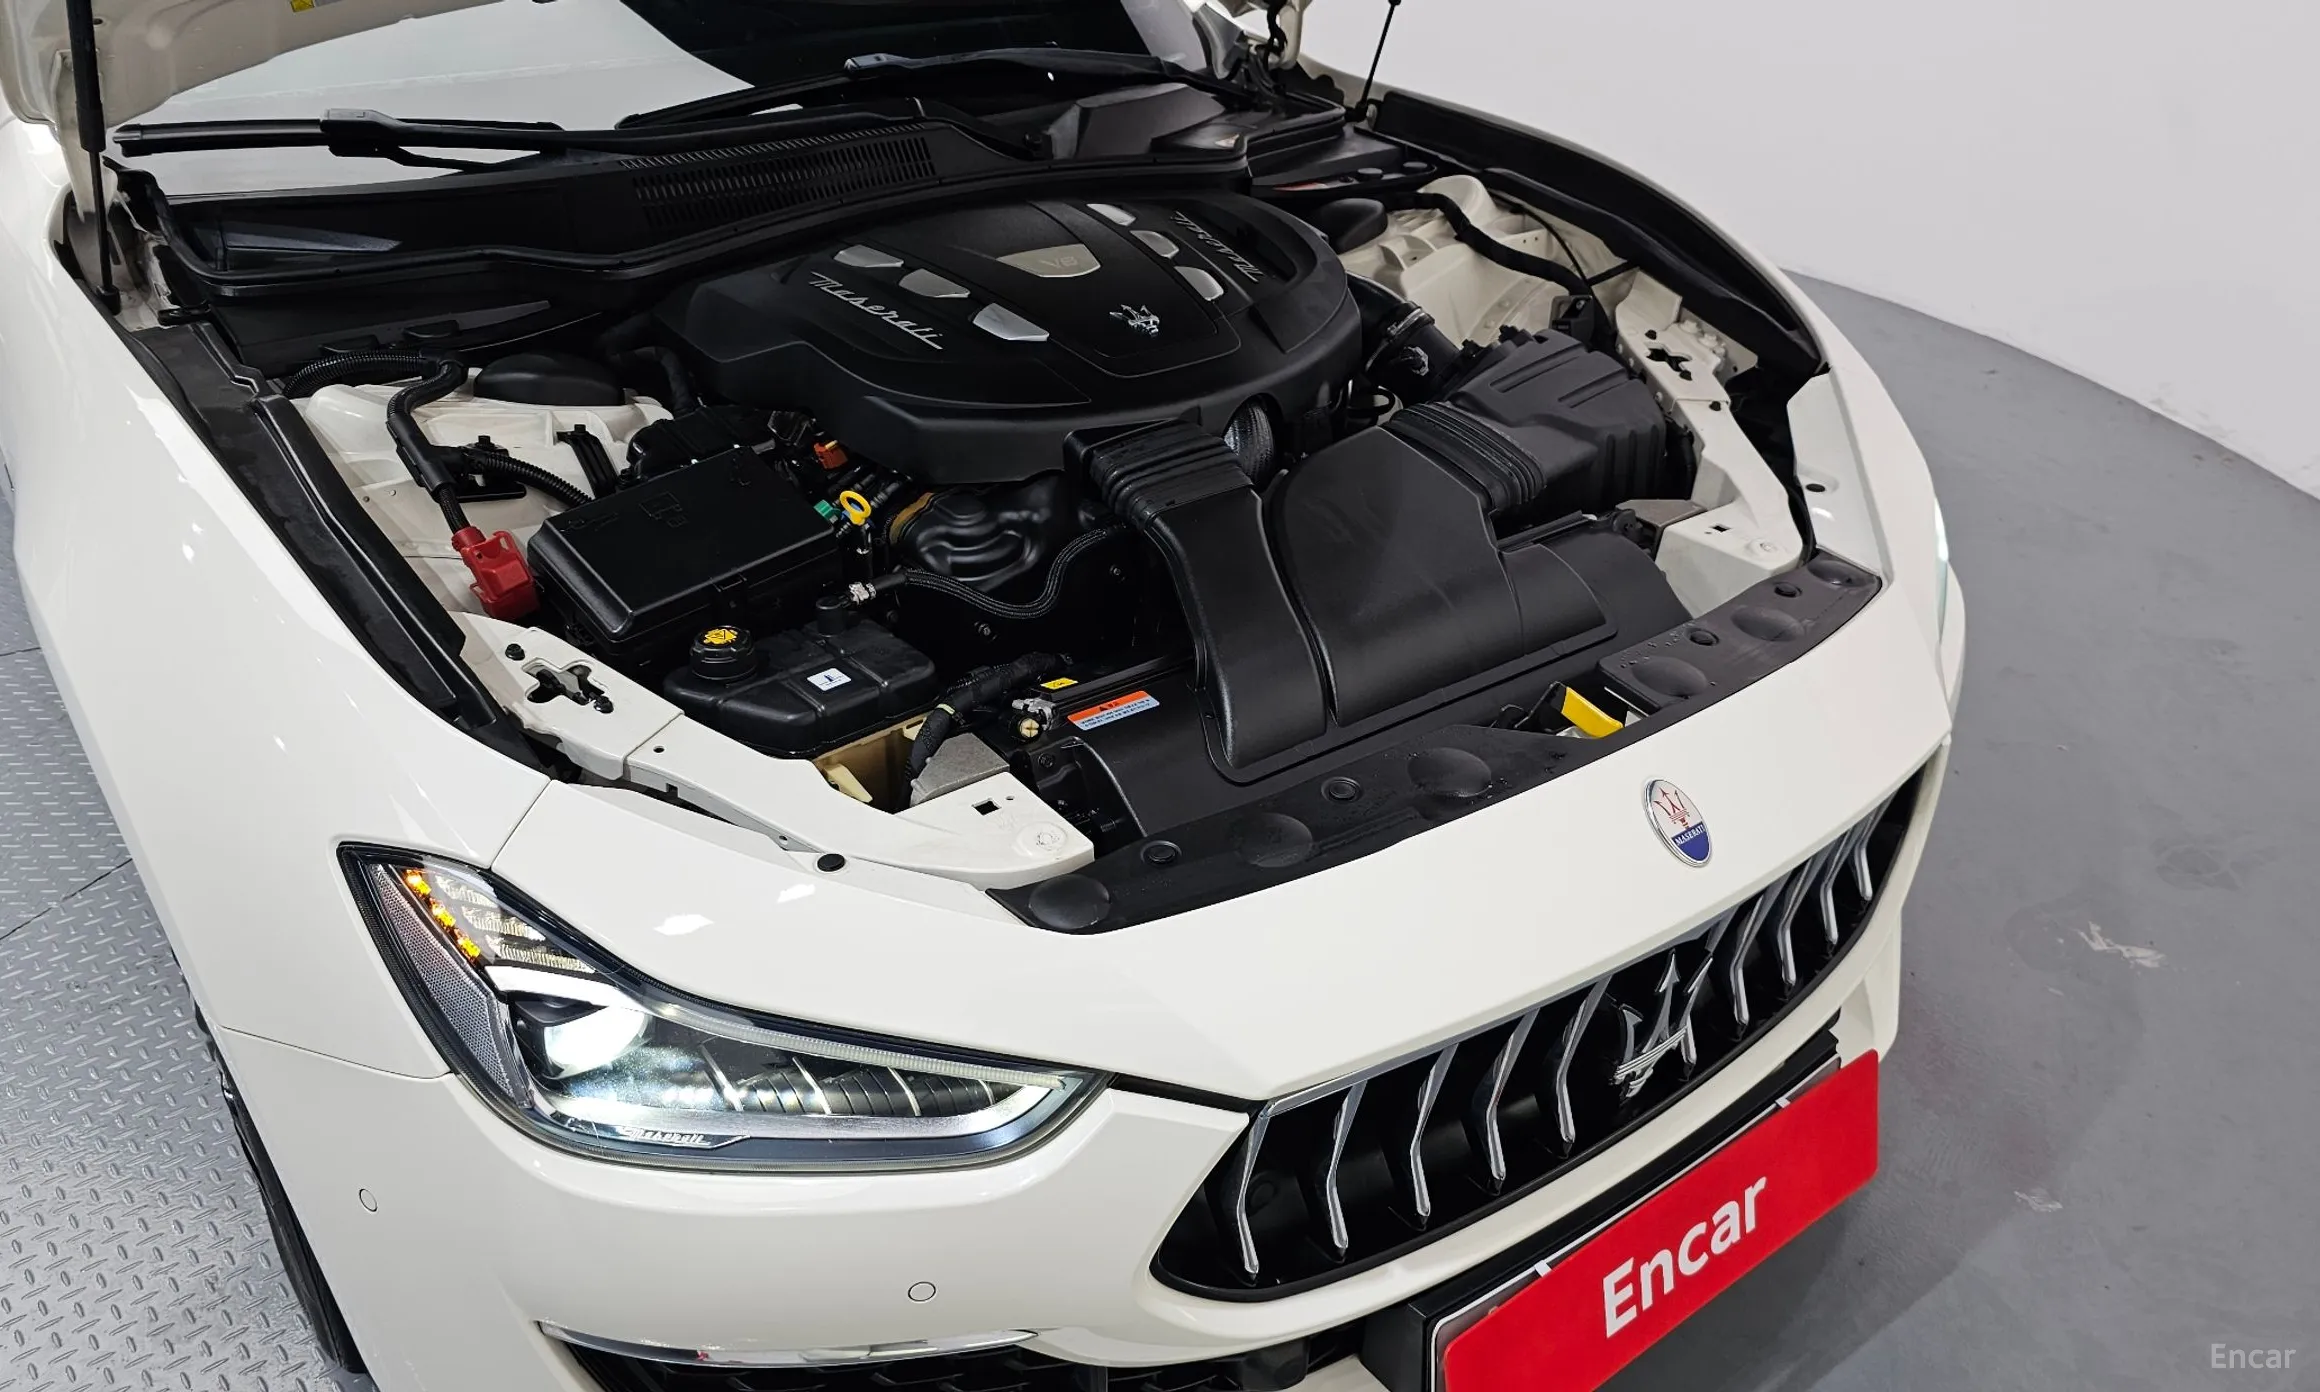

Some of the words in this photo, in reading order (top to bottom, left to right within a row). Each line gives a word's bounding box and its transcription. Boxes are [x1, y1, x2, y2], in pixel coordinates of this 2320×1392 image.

[808, 270, 943, 350] Maserati
[1674, 824, 1705, 846] MASERATI
[1602, 1176, 1767, 1338] Encar
